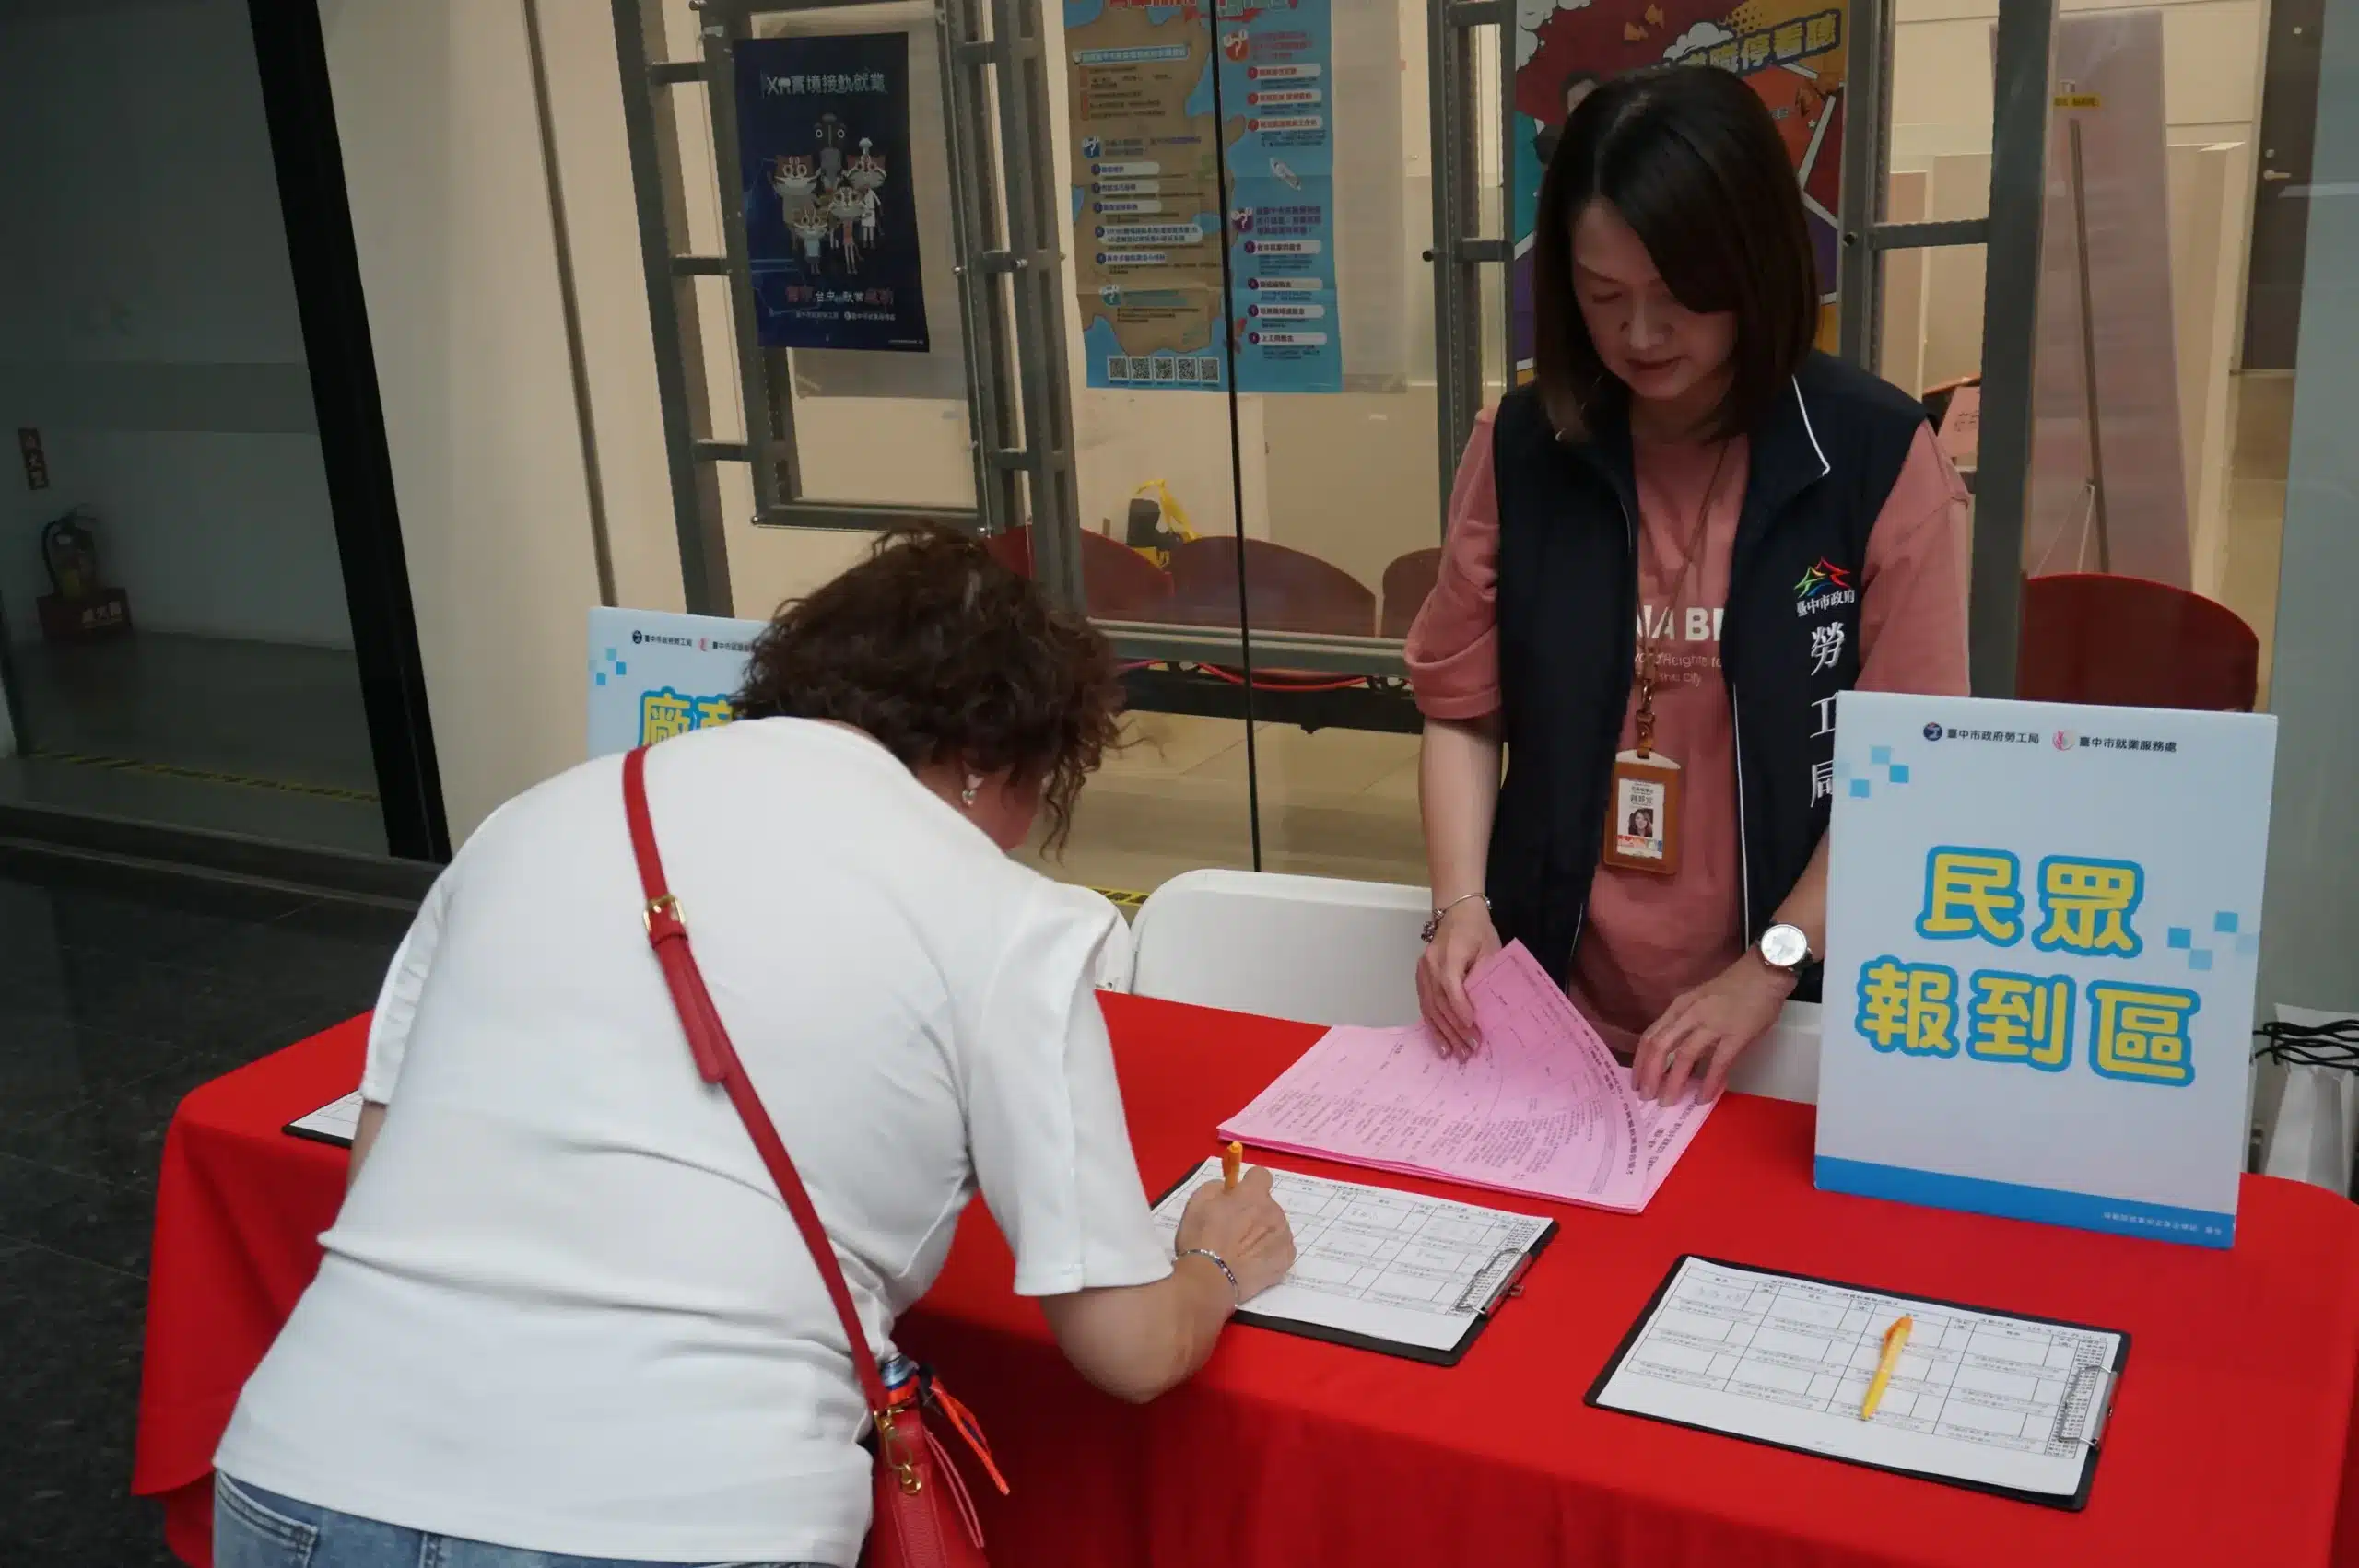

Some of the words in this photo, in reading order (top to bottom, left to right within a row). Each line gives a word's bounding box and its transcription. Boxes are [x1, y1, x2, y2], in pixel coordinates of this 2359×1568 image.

[1796, 589, 1856, 617] 臺中市政府
[1810, 620, 1845, 808] 勞工局
[1945, 727, 2040, 745] 臺中市政府勞工局
[2079, 735, 2177, 754] 臺中市就業服務處
[1915, 845, 2145, 959] 民眾
[1855, 954, 2201, 1087] 報到區
